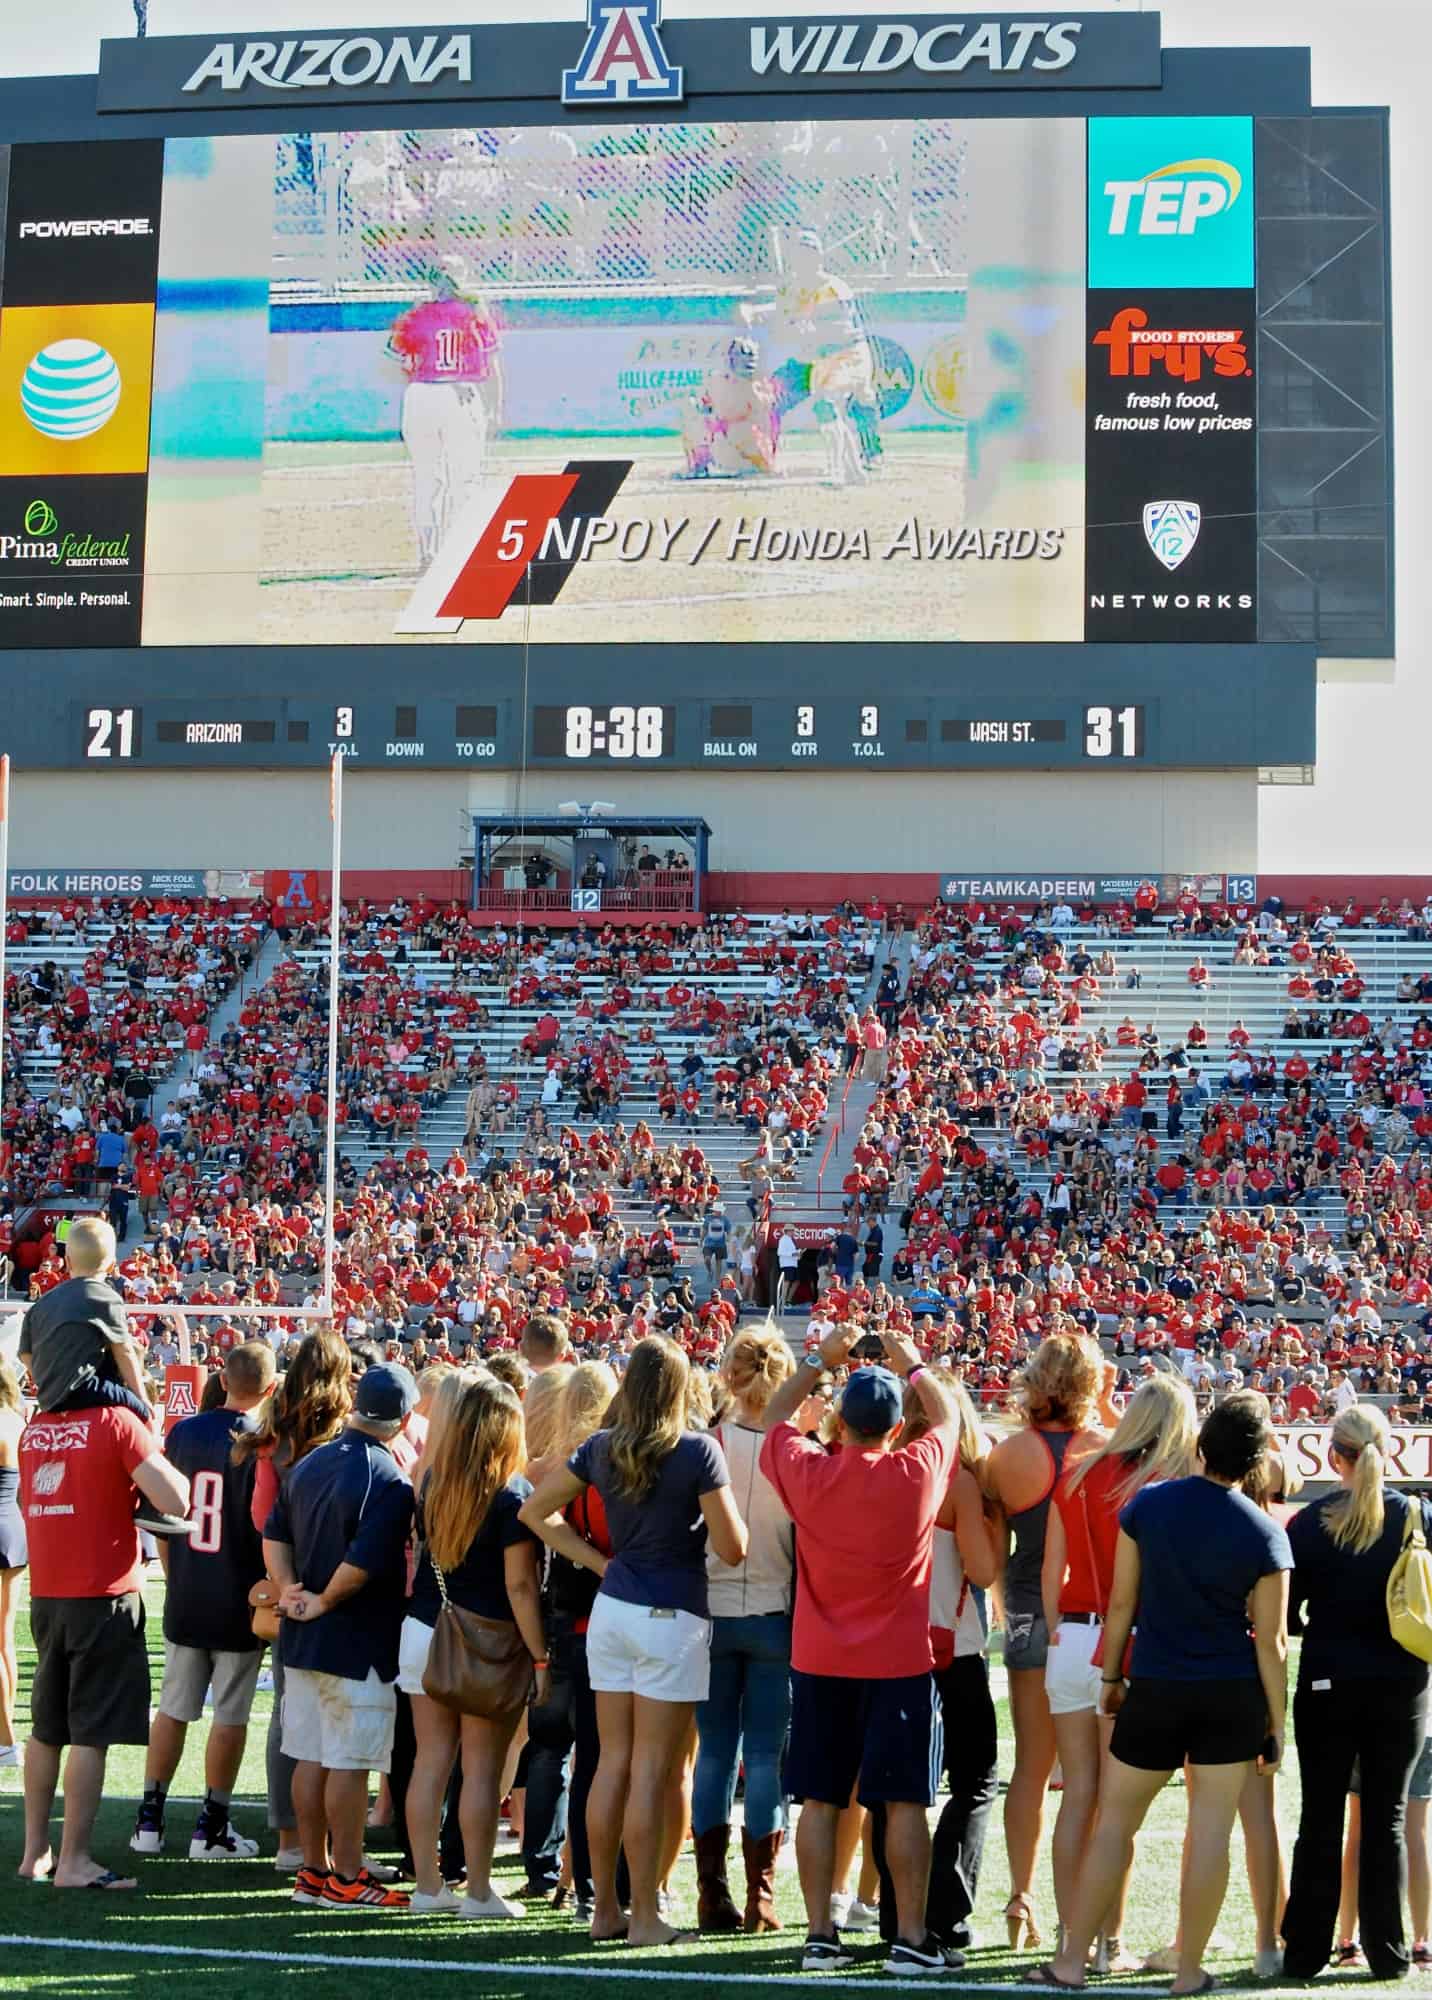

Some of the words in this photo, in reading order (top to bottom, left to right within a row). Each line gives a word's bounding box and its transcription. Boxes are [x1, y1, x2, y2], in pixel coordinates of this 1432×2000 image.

[562, 0, 684, 106] A
[748, 21, 1083, 76] WILDCATS
[182, 34, 472, 91] ARIZONA
[1103, 179, 1227, 237] TEP
[1131, 331, 1173, 343] FOOD
[1177, 331, 1236, 343] STORES
[1126, 392, 1172, 409] fresh
[1175, 392, 1220, 411] food,
[1094, 414, 1161, 431] famous
[1163, 414, 1196, 431] low
[1197, 414, 1253, 433] prices
[496, 518, 529, 562] 5
[537, 516, 690, 562] NPOY
[726, 516, 870, 562] HONDA
[882, 516, 1065, 561] AWARDS
[1162, 537, 1184, 557] 12
[0, 536, 60, 559] Pima
[50, 533, 131, 566] federal
[65, 557, 98, 567] CREDIT
[99, 556, 130, 567] UNION
[36, 591, 77, 609] Simple.
[80, 591, 131, 607] Personal.
[1090, 594, 1253, 609] NETWORKS
[335, 707, 353, 738] 3
[797, 706, 814, 737] 3
[861, 706, 879, 737] 3
[87, 708, 134, 758] 21
[186, 723, 243, 744] ARIZONA
[565, 706, 664, 758] 8:38
[969, 721, 1008, 743] WASH
[1012, 721, 1036, 743] ST.
[1086, 707, 1136, 757] 31
[385, 743, 425, 757] DOWN
[456, 743, 474, 757] TO
[476, 743, 496, 757] GO
[703, 742, 736, 757] BALL
[738, 742, 758, 757] ON
[791, 742, 818, 757] QTR
[10, 875, 60, 892] FOLK
[65, 874, 143, 892] HEROES
[945, 879, 1096, 897] #TEAMKADEEM
[1228, 879, 1254, 899] 13
[573, 891, 598, 910] 12
[794, 1228, 827, 1240] SECTIO
[166, 1381, 198, 1416] A
[188, 1470, 224, 1554] 8
